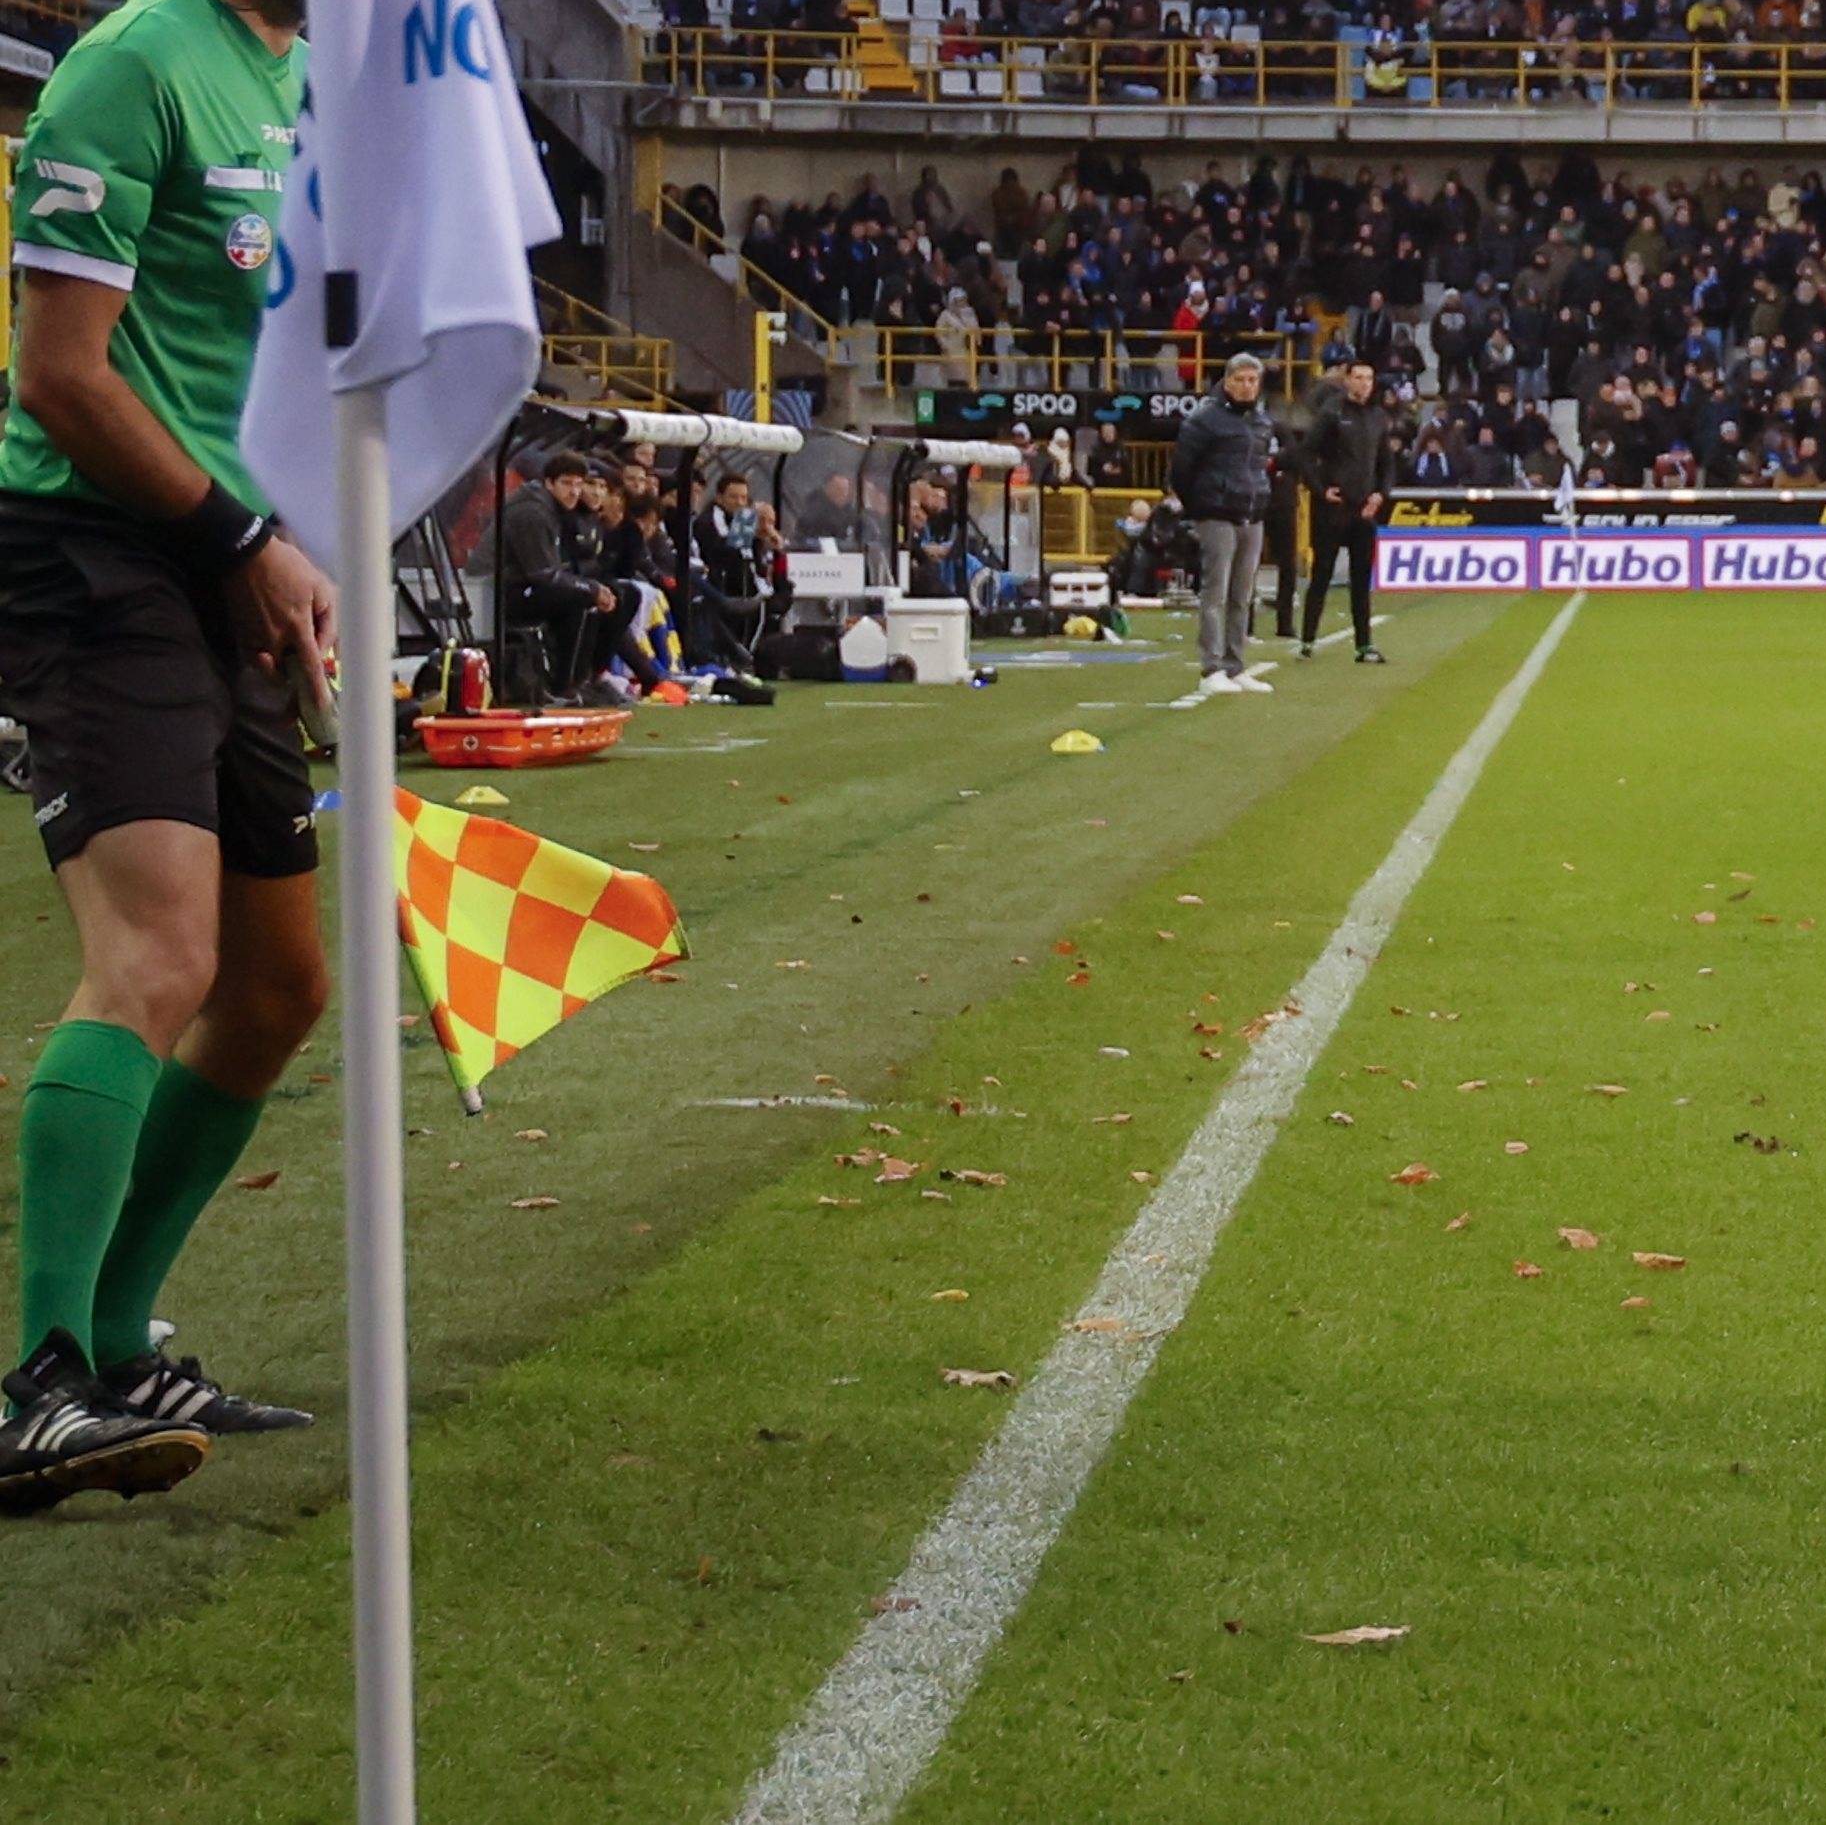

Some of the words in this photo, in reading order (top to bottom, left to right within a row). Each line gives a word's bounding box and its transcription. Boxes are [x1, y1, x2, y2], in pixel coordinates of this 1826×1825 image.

[1013, 394, 1077, 416] SPOQ
[1386, 544, 1519, 584] Hubo
[1548, 545, 1681, 584] Hubo
